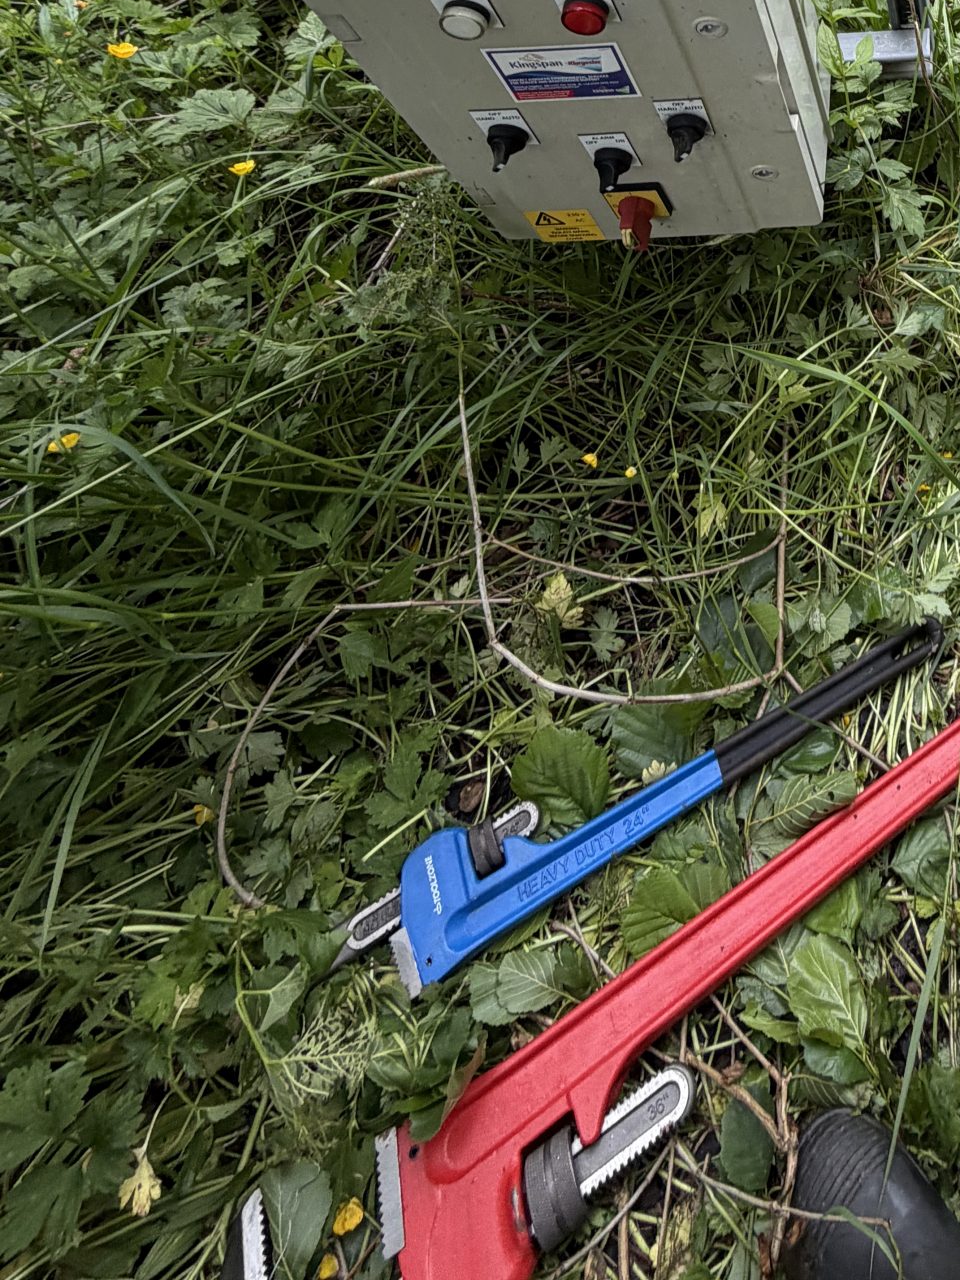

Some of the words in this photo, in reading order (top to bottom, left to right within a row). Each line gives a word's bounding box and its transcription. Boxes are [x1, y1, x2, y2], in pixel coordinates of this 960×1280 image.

[509, 61, 563, 69] Kingspan
[424, 854, 441, 905] TOOLZONE
[517, 856, 569, 902] HEAVY
[574, 827, 615, 866] DUTY
